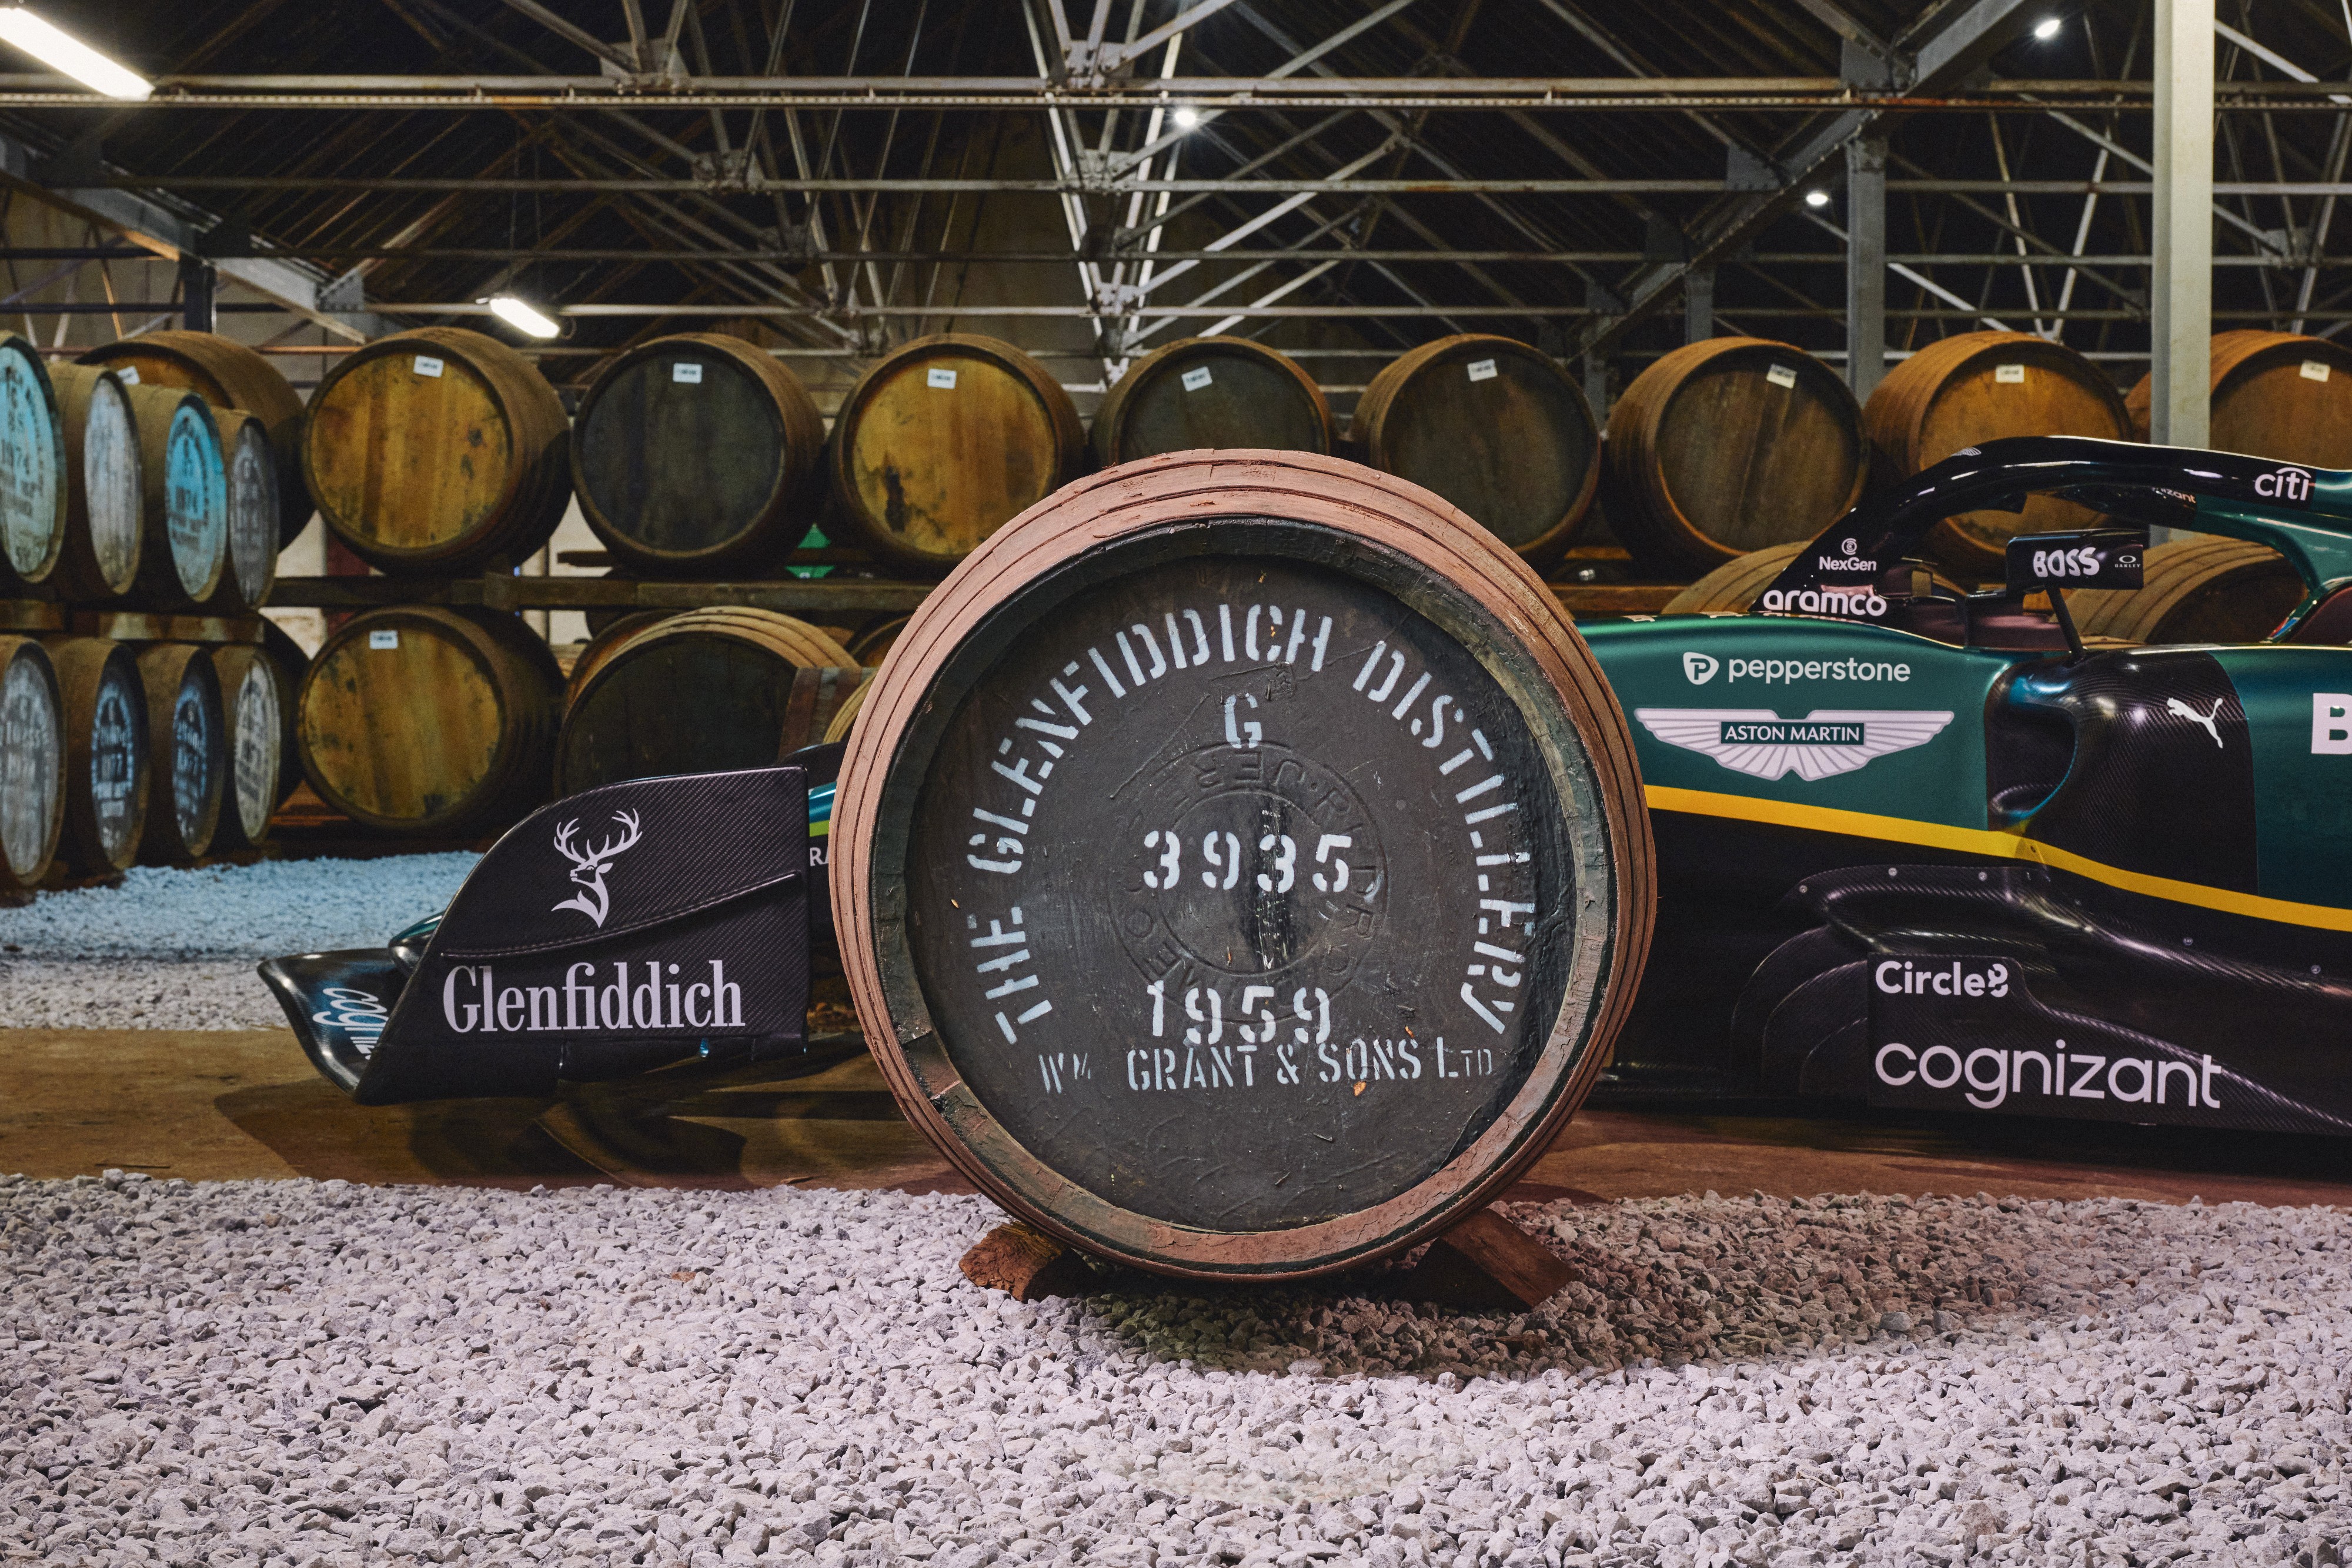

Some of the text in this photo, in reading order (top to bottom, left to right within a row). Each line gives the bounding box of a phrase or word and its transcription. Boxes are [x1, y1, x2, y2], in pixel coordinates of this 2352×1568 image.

[2254, 467, 2311, 501] citi
[1819, 556, 1877, 571] NexGen
[2033, 547, 2100, 577] BOSS
[1763, 589, 1887, 617] aramco
[1729, 658, 1910, 684] pepperstone
[1224, 693, 1262, 748] G
[1725, 726, 1859, 741] ASTON MARTIN
[967, 604, 1536, 1045] THE GLENFIDDICH DISTILLERY
[1144, 831, 1353, 894] 3935
[443, 960, 745, 1033] Glenfiddich
[1147, 980, 1331, 1045] 1959
[1127, 1044, 1258, 1091] GRANT
[1277, 1044, 1300, 1085] &
[1318, 1038, 1422, 1083] SONS
[1875, 1039, 2223, 1109] cognizant
